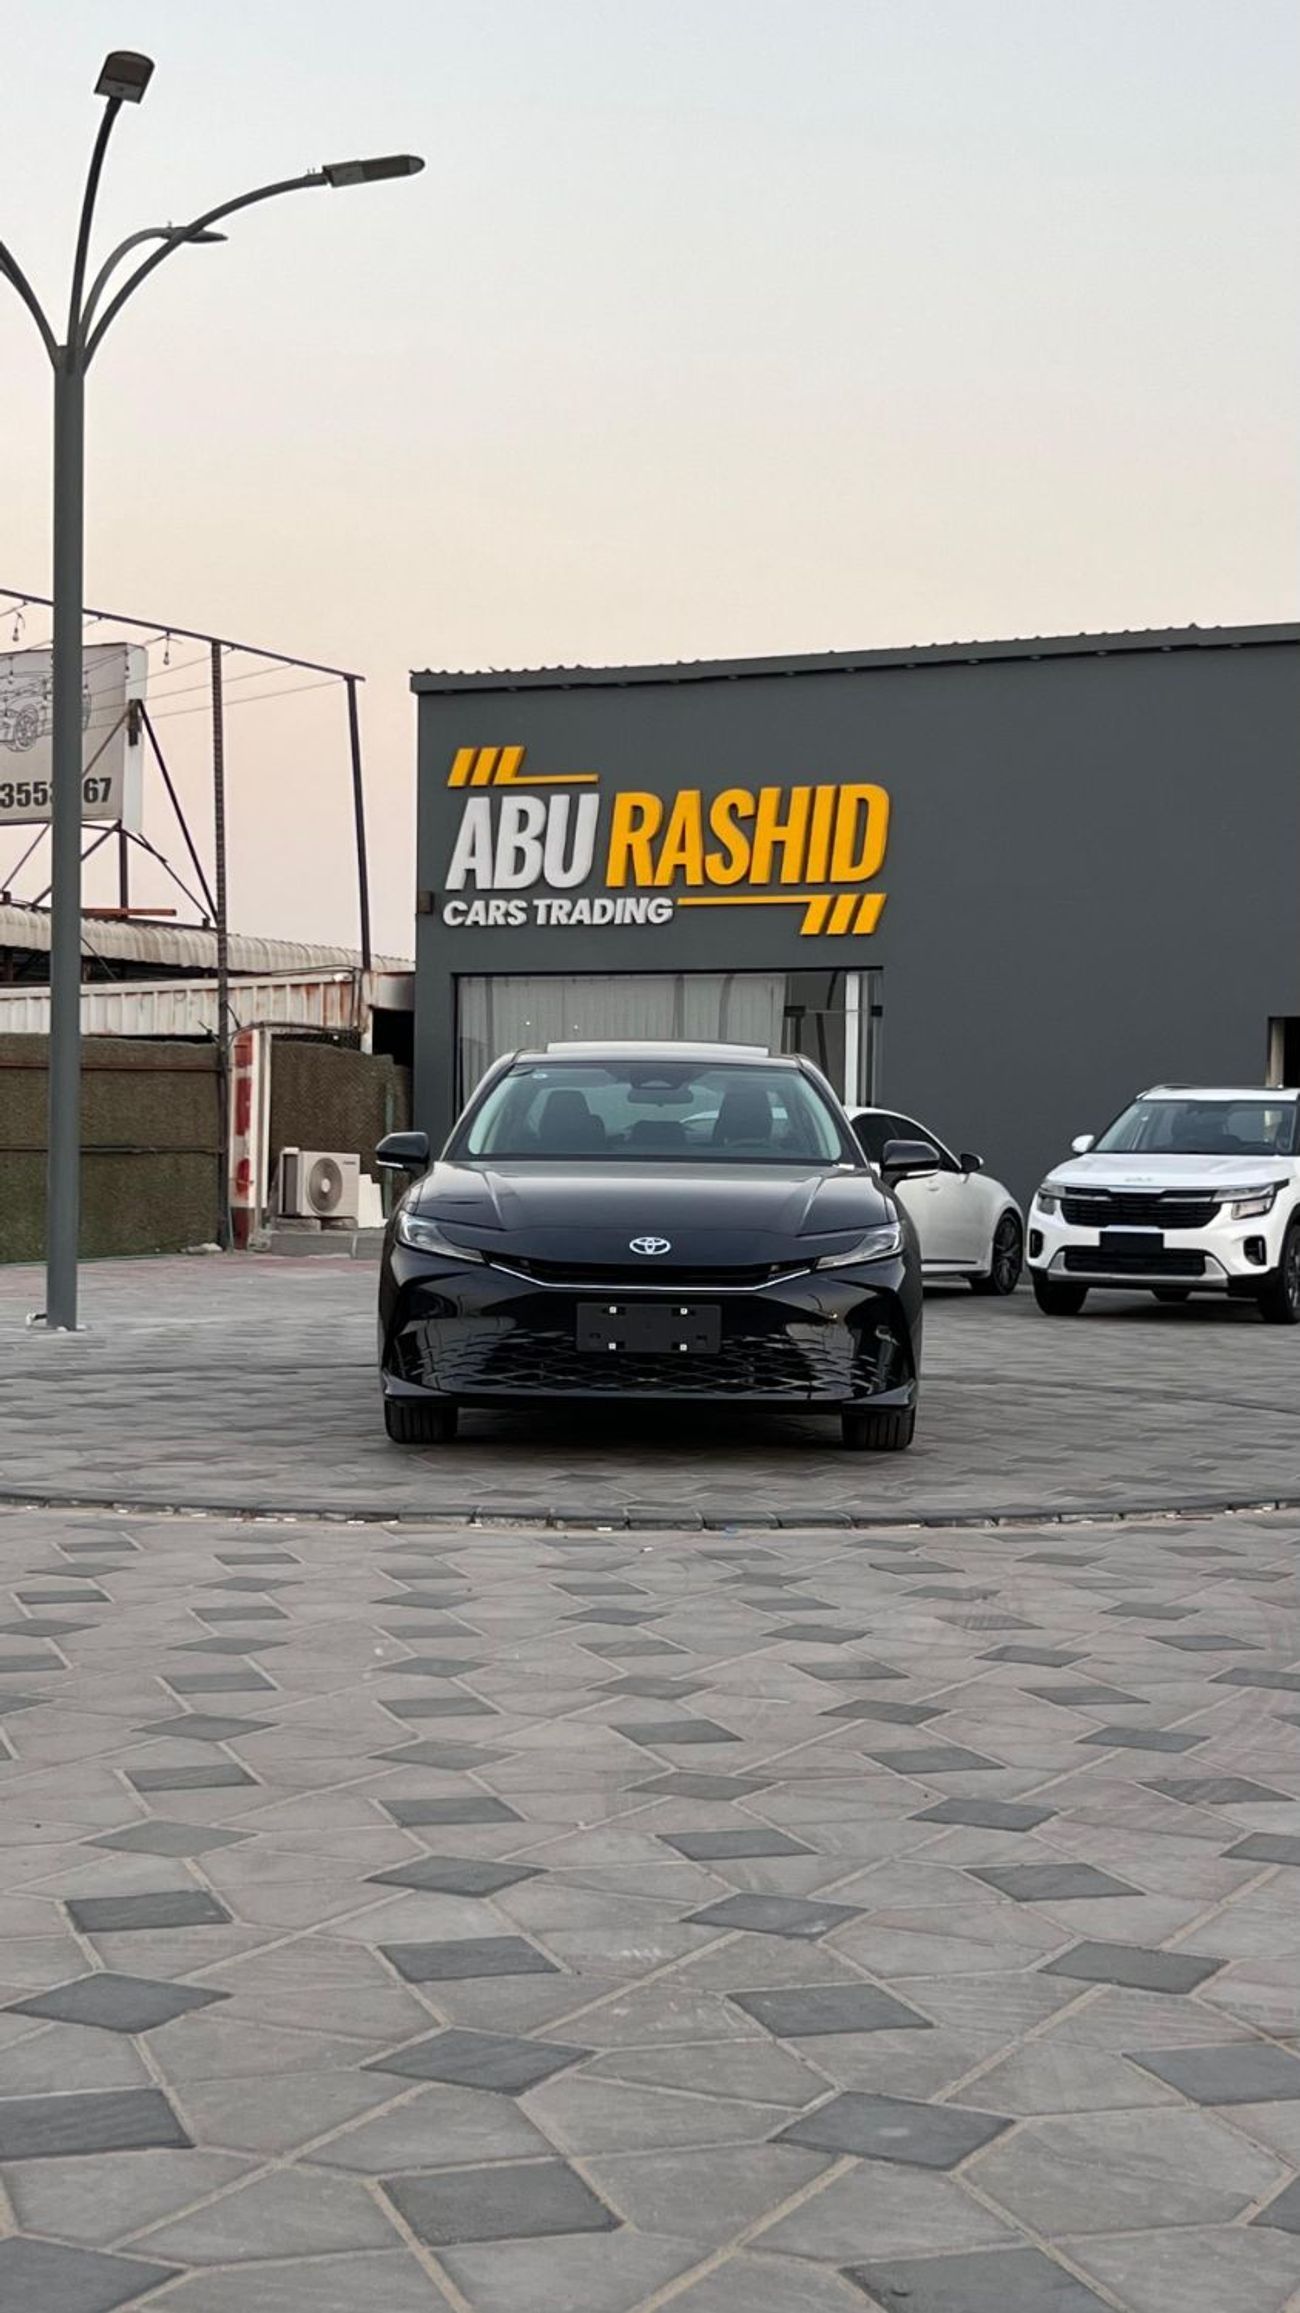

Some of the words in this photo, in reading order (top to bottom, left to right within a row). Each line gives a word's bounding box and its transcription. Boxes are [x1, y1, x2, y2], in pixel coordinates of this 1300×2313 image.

[0, 777, 112, 809] 35567
[445, 793, 600, 890] ABU
[605, 783, 890, 888] RASHID
[443, 899, 527, 926] CARS
[533, 897, 674, 925] TRADING
